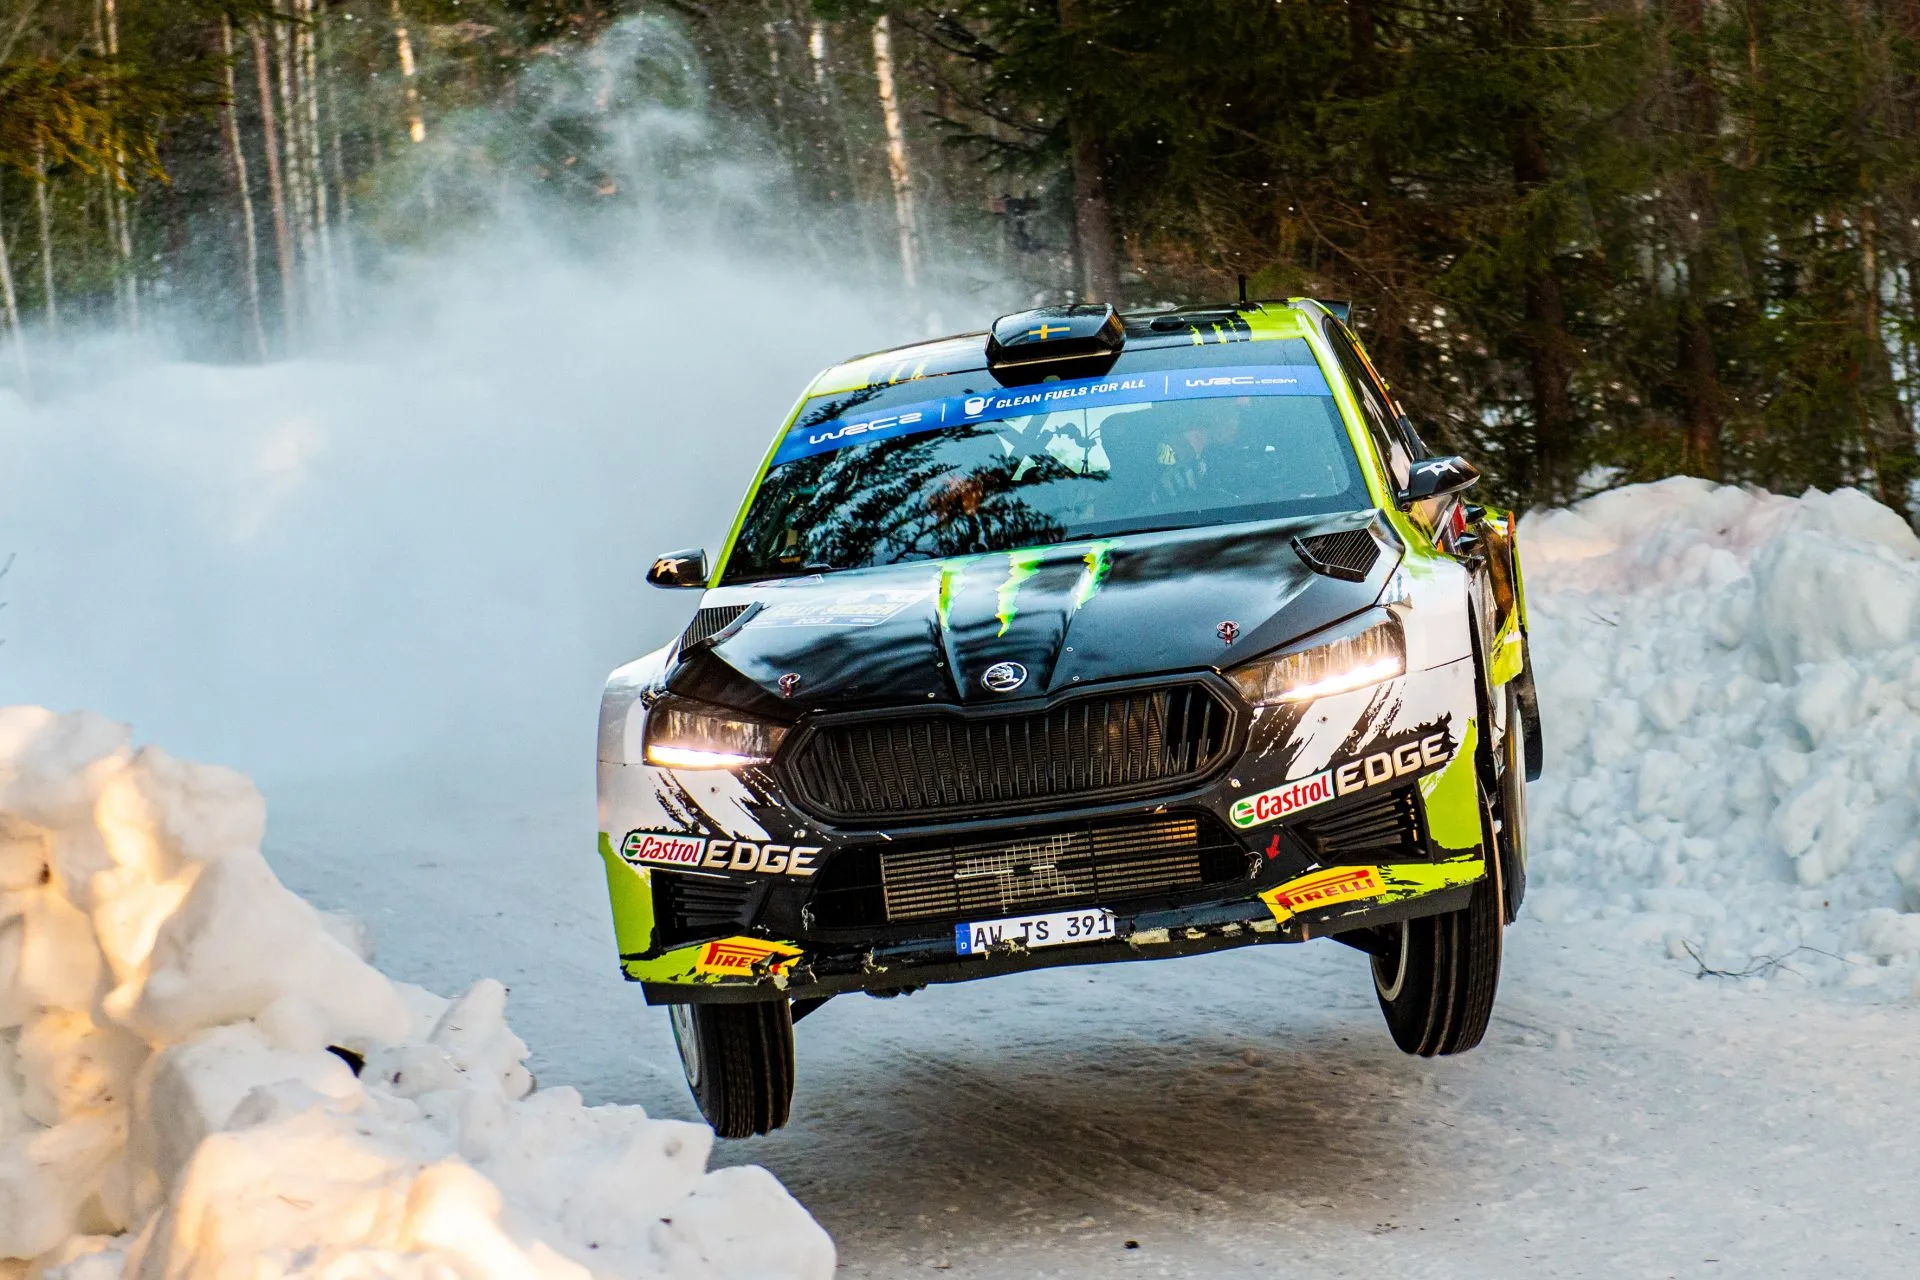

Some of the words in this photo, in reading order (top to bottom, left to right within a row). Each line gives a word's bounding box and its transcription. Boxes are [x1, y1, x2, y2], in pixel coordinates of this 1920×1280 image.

[996, 393, 1041, 409] CLEAN
[1044, 385, 1088, 401] FUELS
[1090, 382, 1117, 395] FOR
[1120, 378, 1146, 391] ALL
[809, 412, 922, 445] WRC2
[1255, 774, 1331, 820] Castrol
[1335, 732, 1450, 797] EDGE
[640, 836, 701, 863] Castrol
[701, 839, 823, 876] EDGE
[1274, 869, 1376, 911] PIRELLI
[960, 942, 968, 950] D
[974, 925, 1003, 948] AW
[1020, 920, 1049, 942] TS
[1066, 915, 1112, 938] 391
